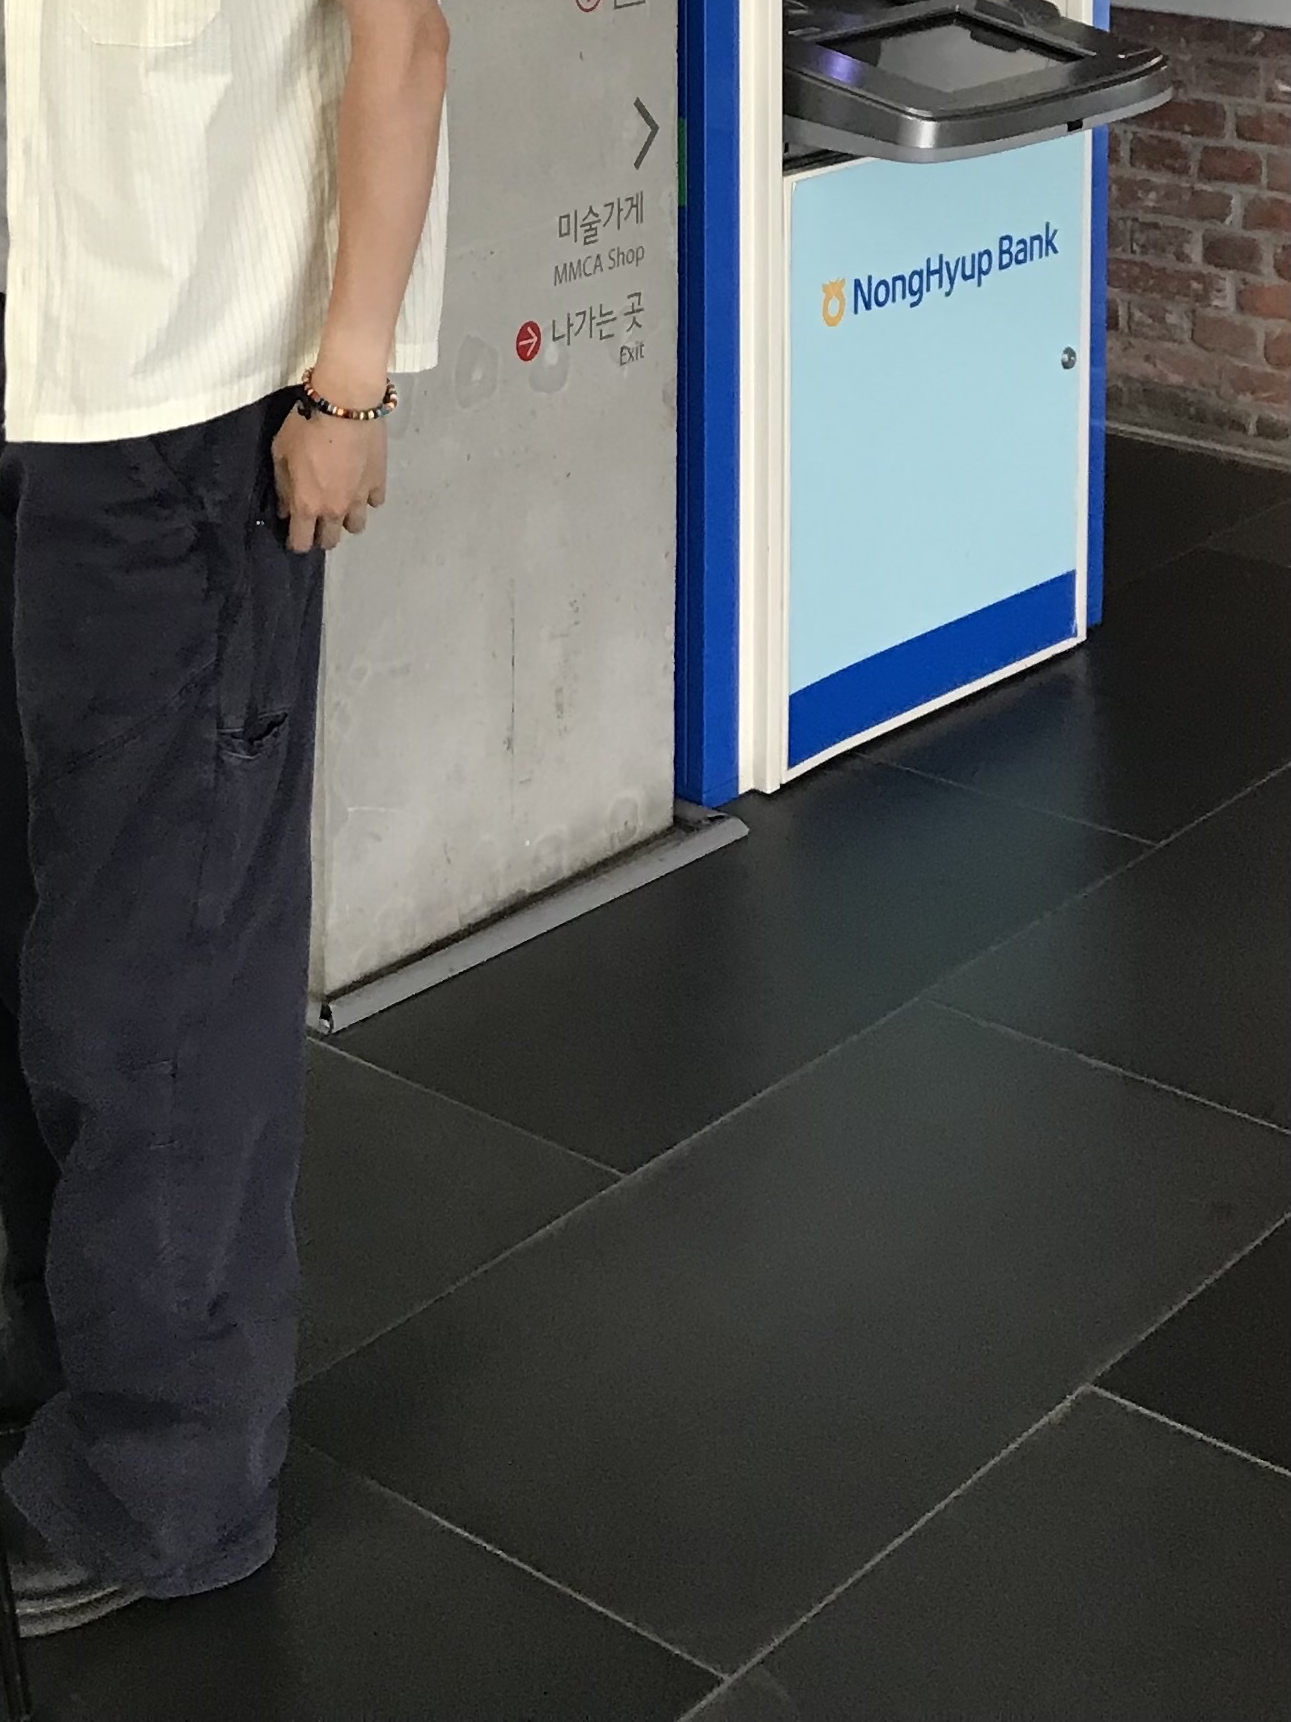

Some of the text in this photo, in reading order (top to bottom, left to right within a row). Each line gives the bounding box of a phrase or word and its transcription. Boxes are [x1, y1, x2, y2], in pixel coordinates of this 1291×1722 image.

[557, 190, 645, 246] 미술가게
[553, 244, 646, 287] MMCA Shop
[852, 221, 1058, 315] NongHyup Bank
[551, 291, 645, 346] 나가는 곳
[619, 340, 645, 367] Exit
